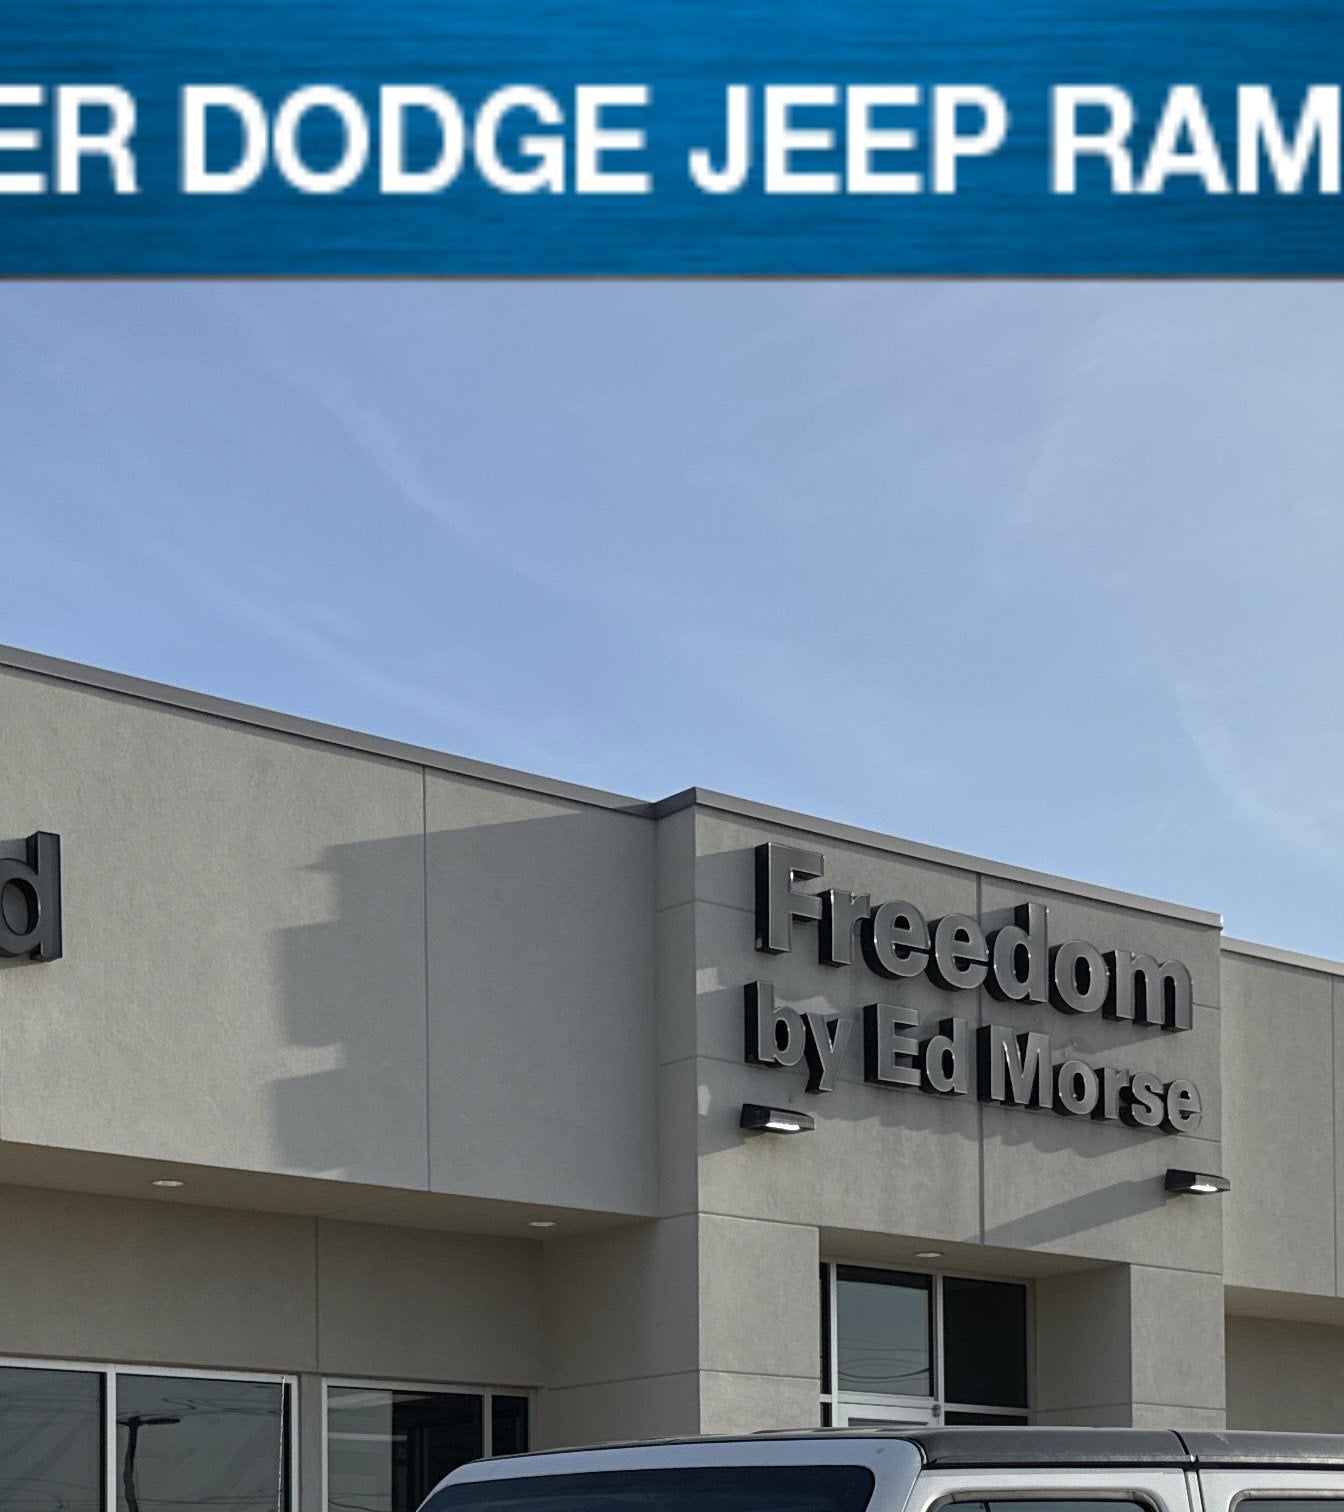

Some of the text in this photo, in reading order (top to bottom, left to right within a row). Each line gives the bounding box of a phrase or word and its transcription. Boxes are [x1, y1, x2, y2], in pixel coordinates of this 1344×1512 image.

[754, 841, 1194, 1032] Freedom
[743, 979, 1203, 1133] by Ed Morse
